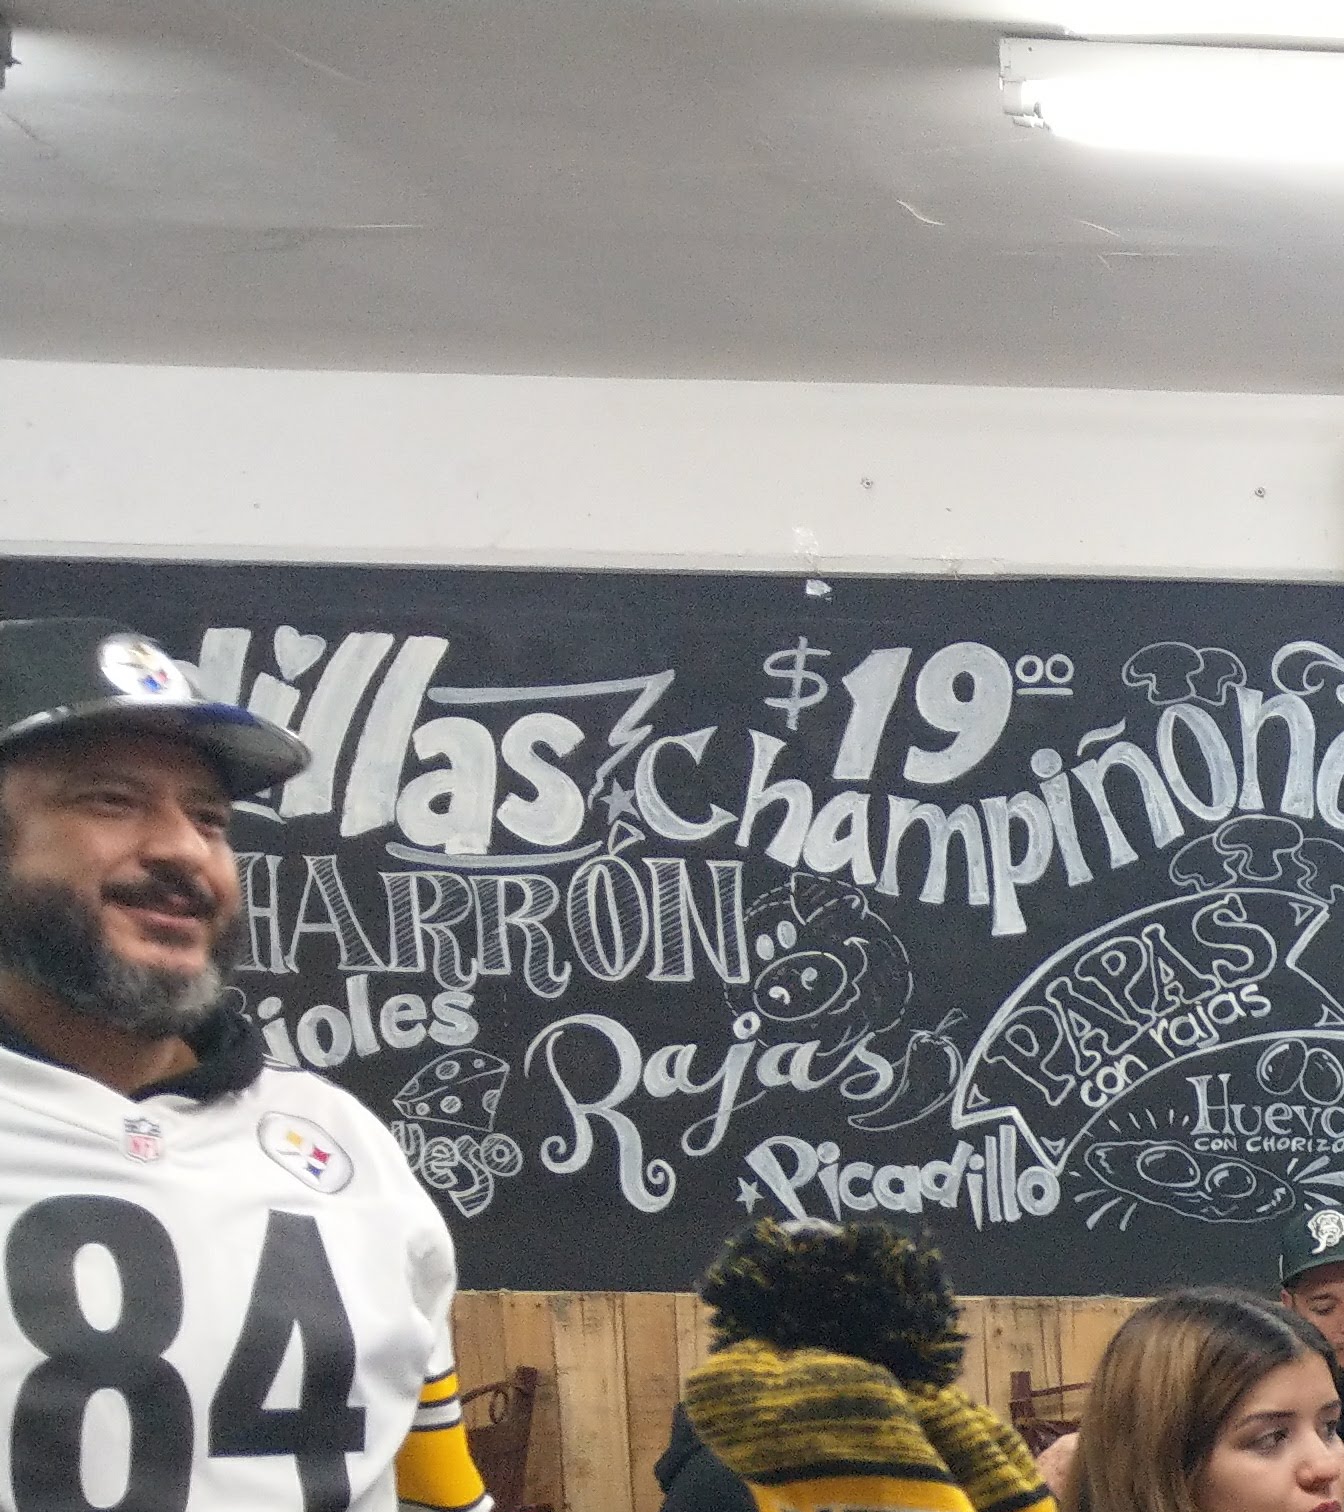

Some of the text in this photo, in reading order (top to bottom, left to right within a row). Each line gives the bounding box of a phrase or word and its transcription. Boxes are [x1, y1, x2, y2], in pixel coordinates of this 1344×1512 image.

[236, 821, 750, 998] HARRÓN
[984, 894, 1278, 1107] PAPAS
[1081, 983, 1273, 1108] con rajas
[390, 1119, 522, 1218] ueso
[524, 1012, 895, 1213] Rajas
[1194, 1135, 1239, 1153] CON
[746, 1123, 1062, 1231] Picadillo
